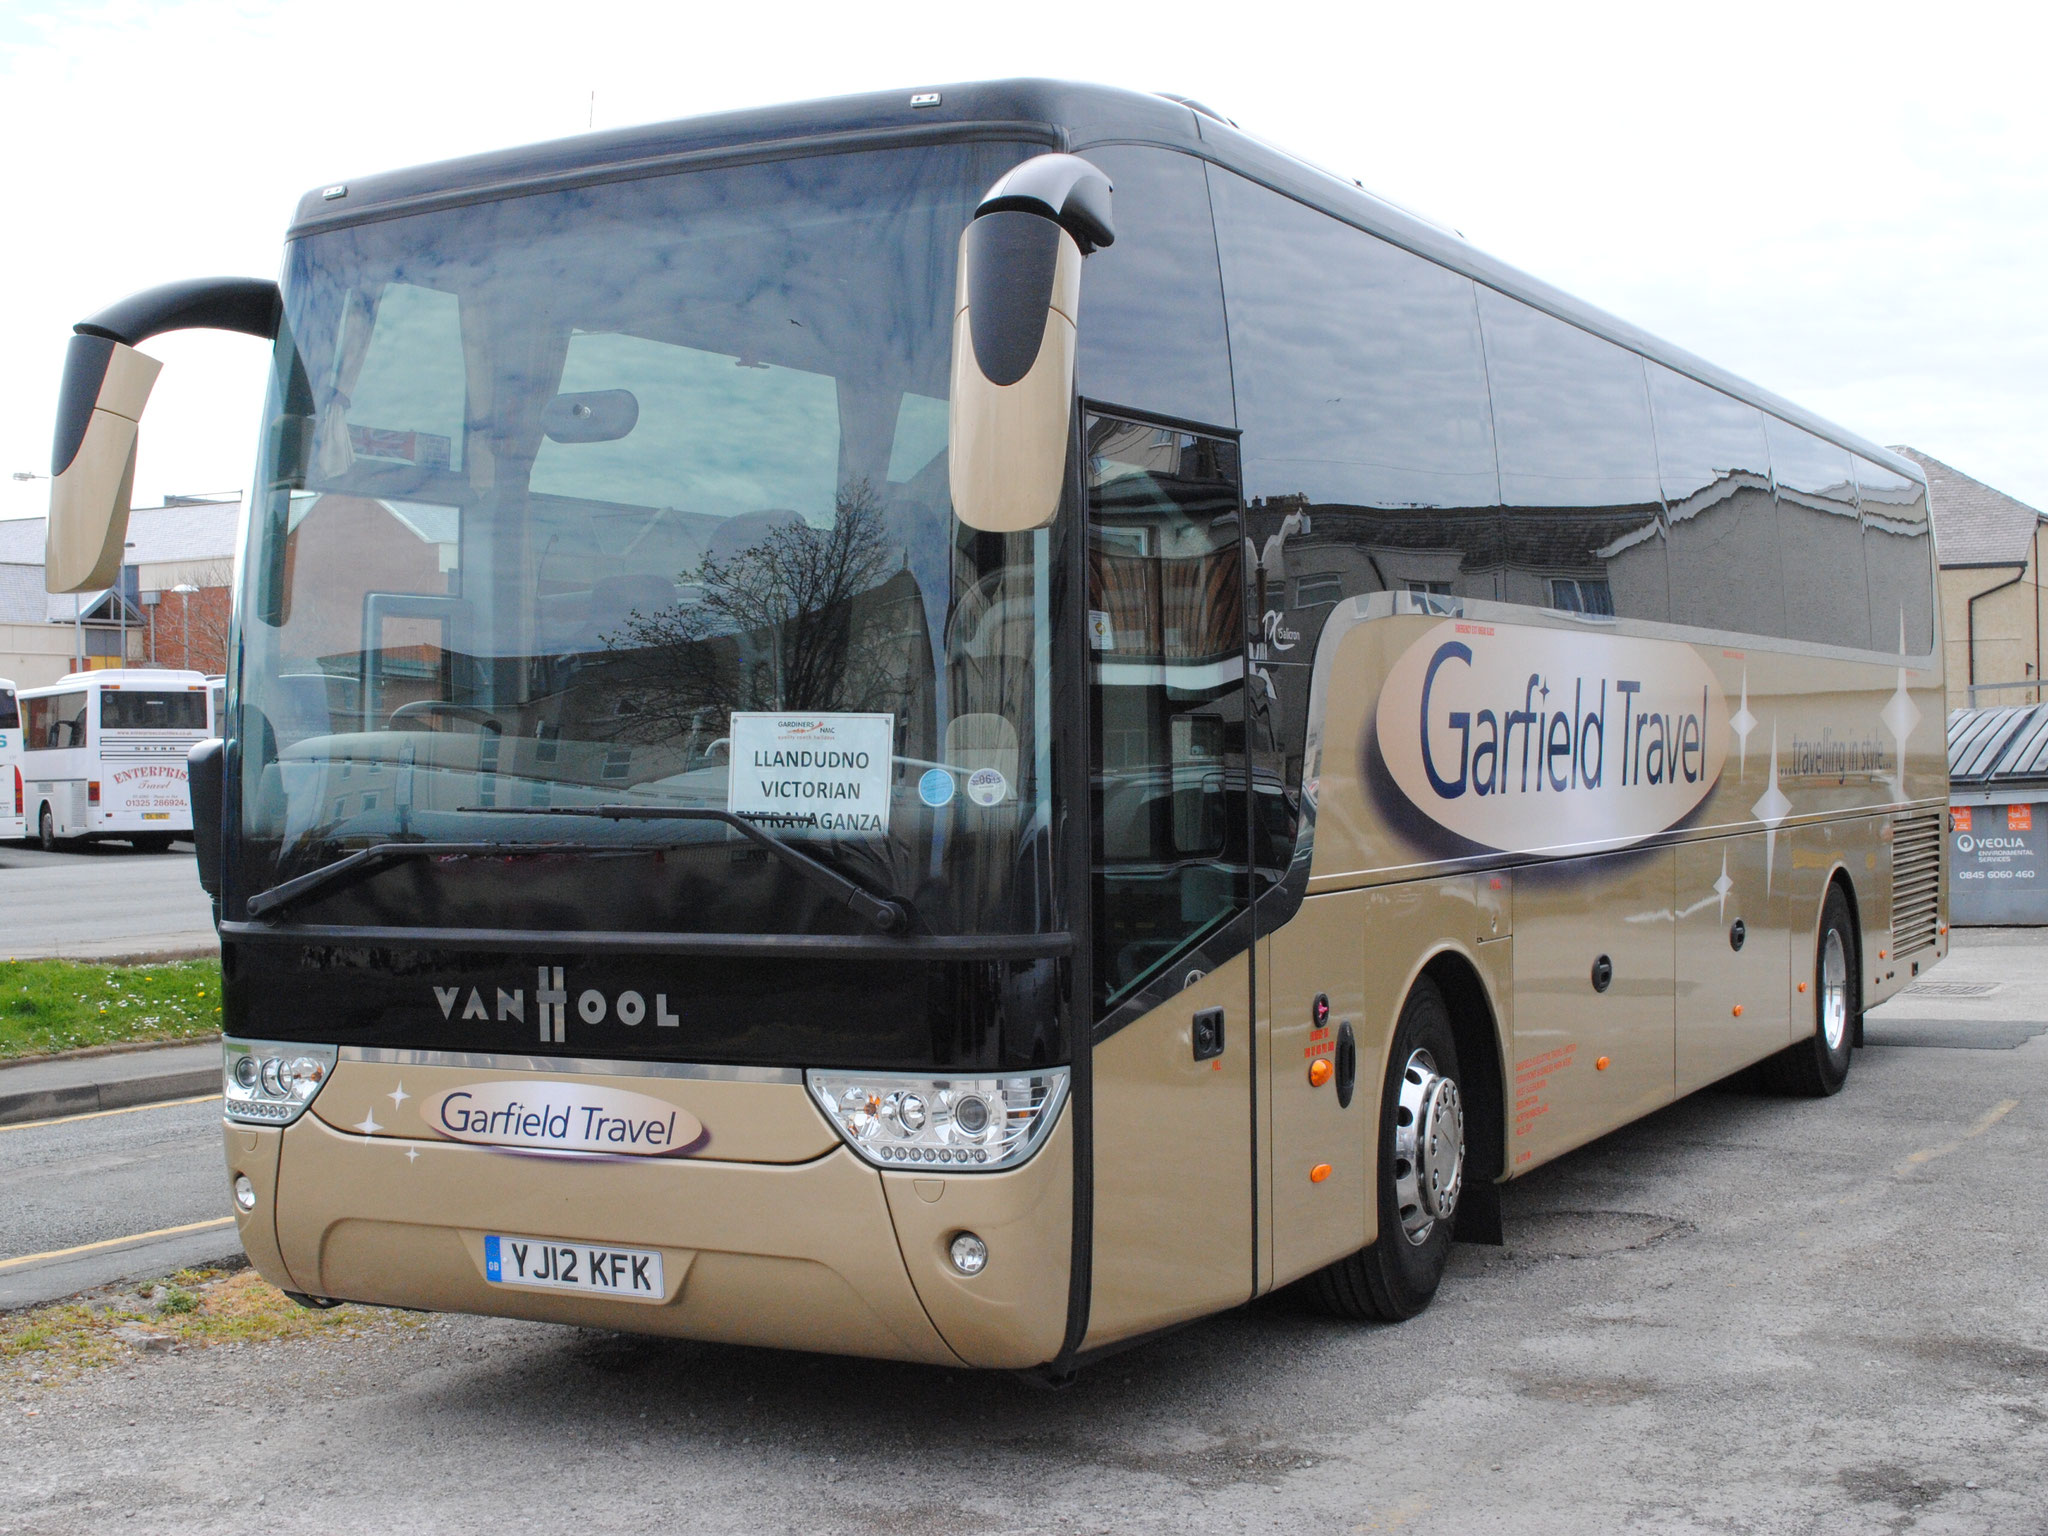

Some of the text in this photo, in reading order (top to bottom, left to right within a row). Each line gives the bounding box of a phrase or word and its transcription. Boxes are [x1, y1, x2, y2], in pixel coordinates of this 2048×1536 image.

[1420, 640, 1708, 799] Garfield Travel
[754, 750, 869, 769] LLANDUDNO
[113, 766, 190, 784] ENTERPRIS
[761, 780, 861, 800] VICTORIAN
[125, 799, 151, 807] 01325
[736, 810, 882, 831] XTRAVAGANZA
[1975, 838, 2025, 849] VEOLIA
[1959, 869, 2035, 880] 0845 6060 460
[440, 1091, 676, 1145] Garfield Travel
[511, 1243, 651, 1291] YJ12 KFK
